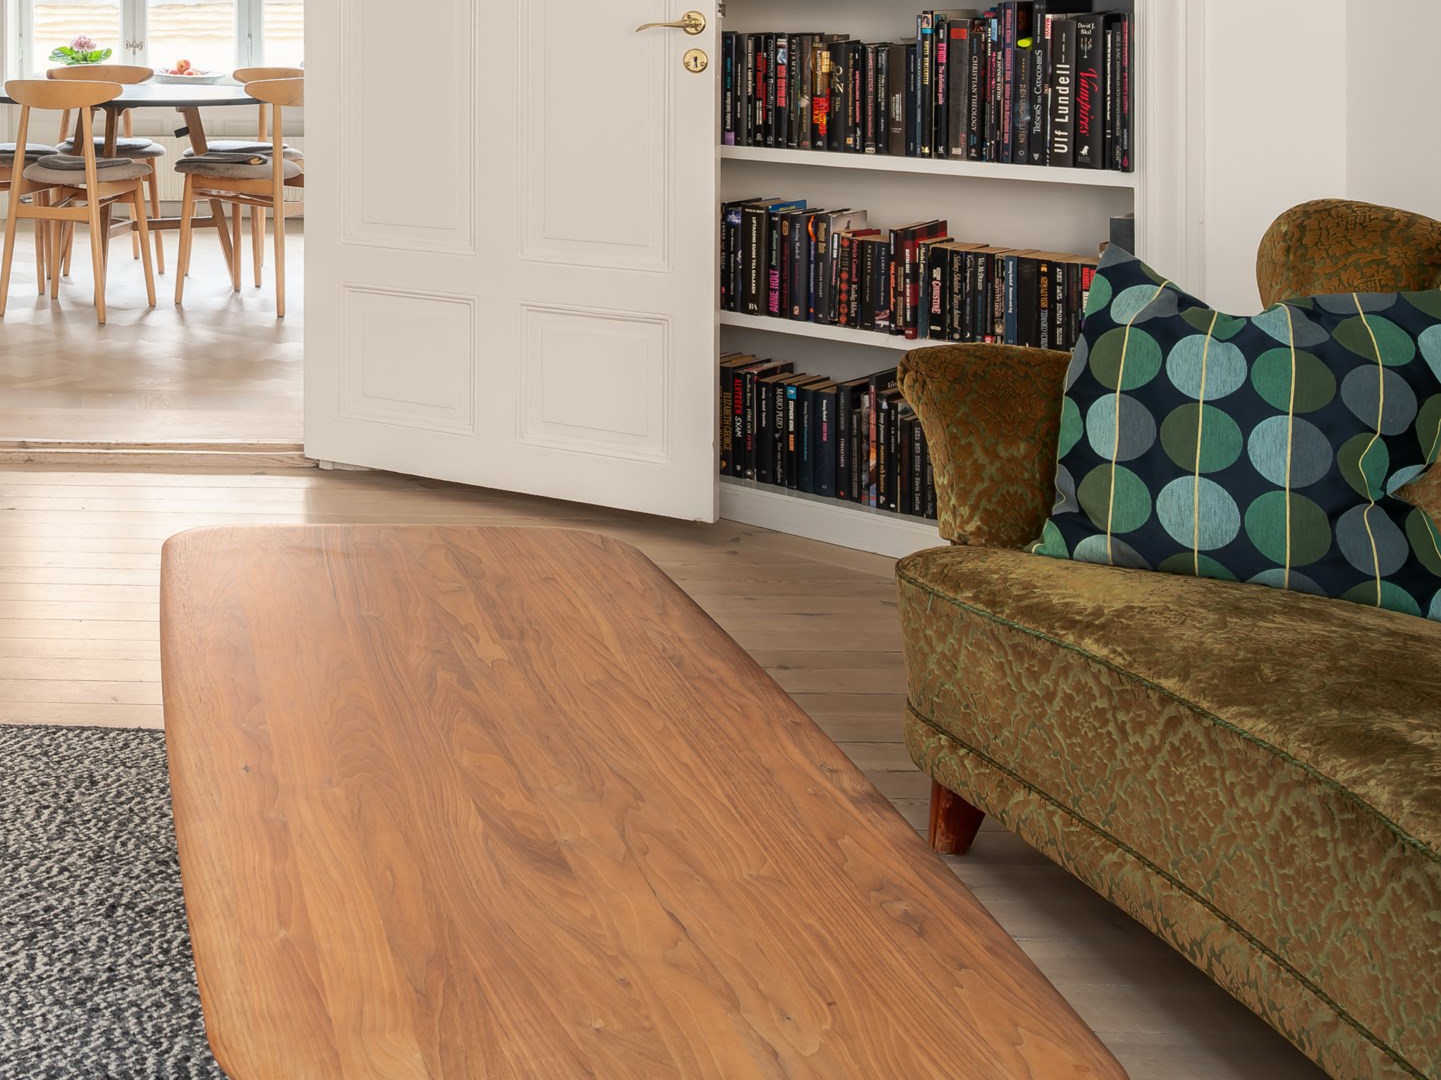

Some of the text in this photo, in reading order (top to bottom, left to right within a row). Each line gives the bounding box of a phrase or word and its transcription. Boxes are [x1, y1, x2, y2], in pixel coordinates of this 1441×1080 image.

[1054, 64, 1070, 153] Ulf Lundell
[1076, 68, 1098, 136] Vampires
